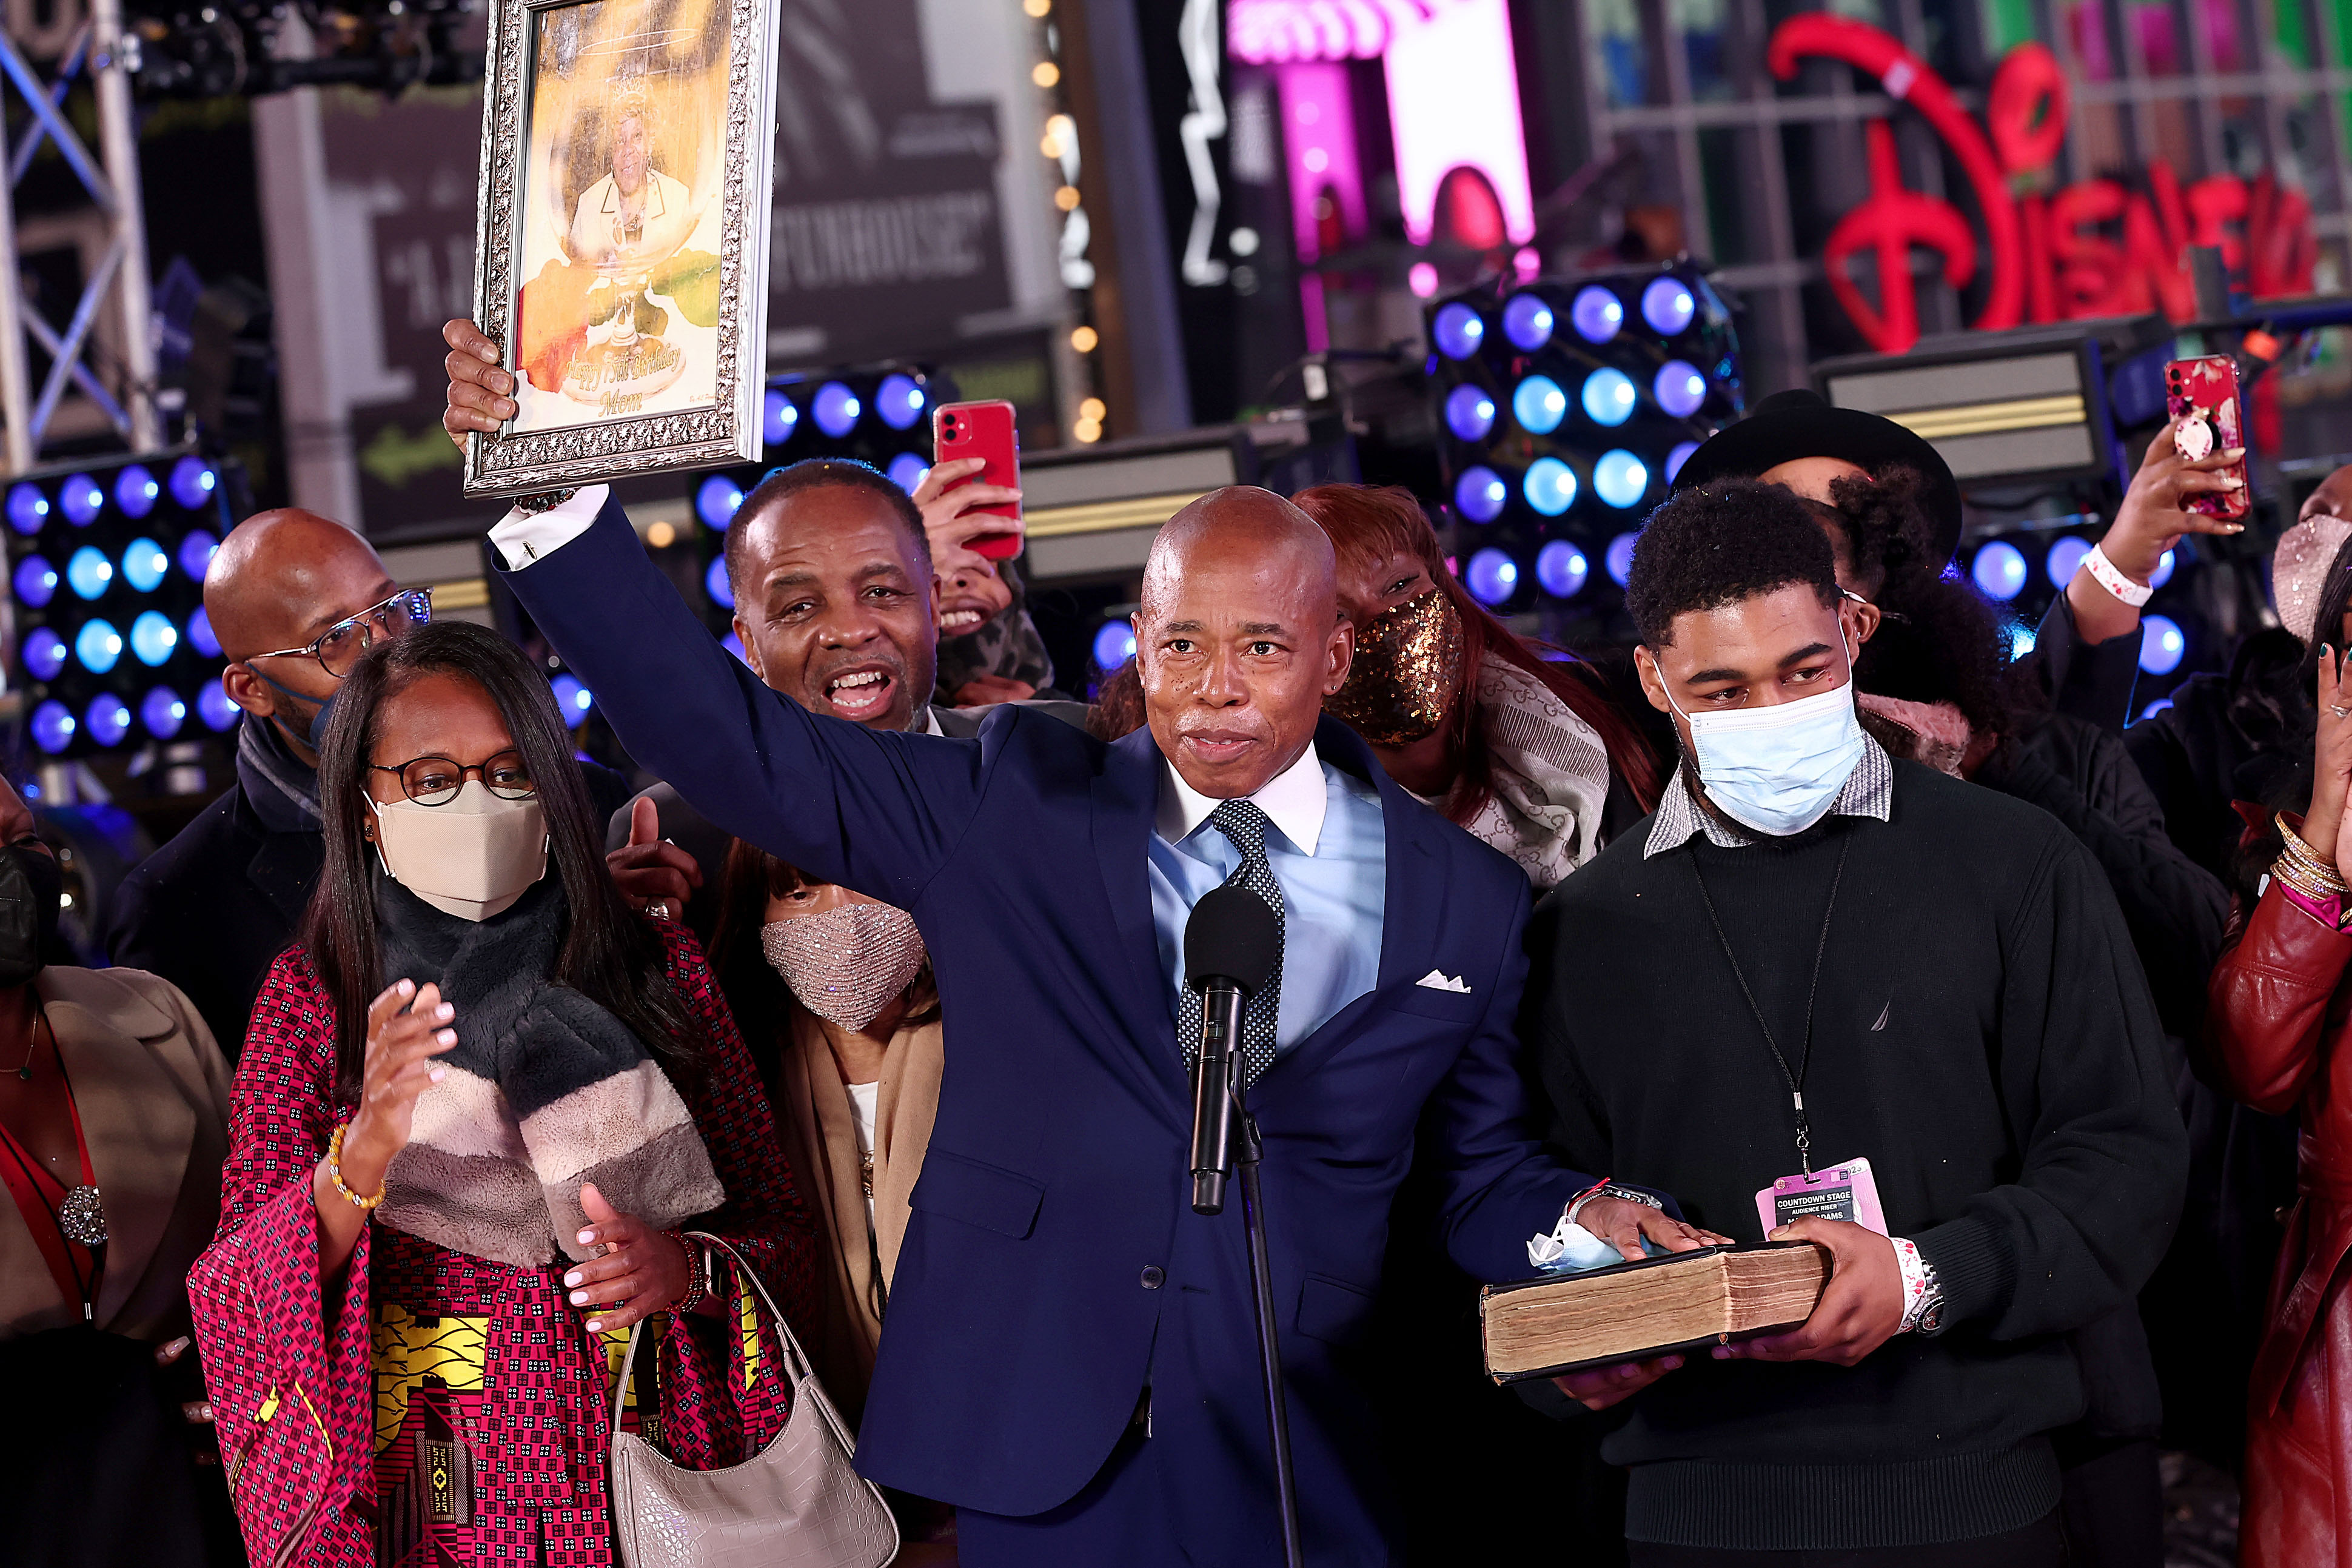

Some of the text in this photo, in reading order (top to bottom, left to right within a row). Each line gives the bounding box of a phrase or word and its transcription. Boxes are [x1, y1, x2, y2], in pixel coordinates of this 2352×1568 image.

[566, 358, 601, 391] Happy
[632, 343, 680, 379] Birthday
[598, 389, 643, 418] Mom
[1777, 1191, 1851, 1208] COUNTDOWN STAGE
[1792, 1206, 1820, 1215] AUDIENCE
[1817, 1211, 1843, 1220] DAMS
